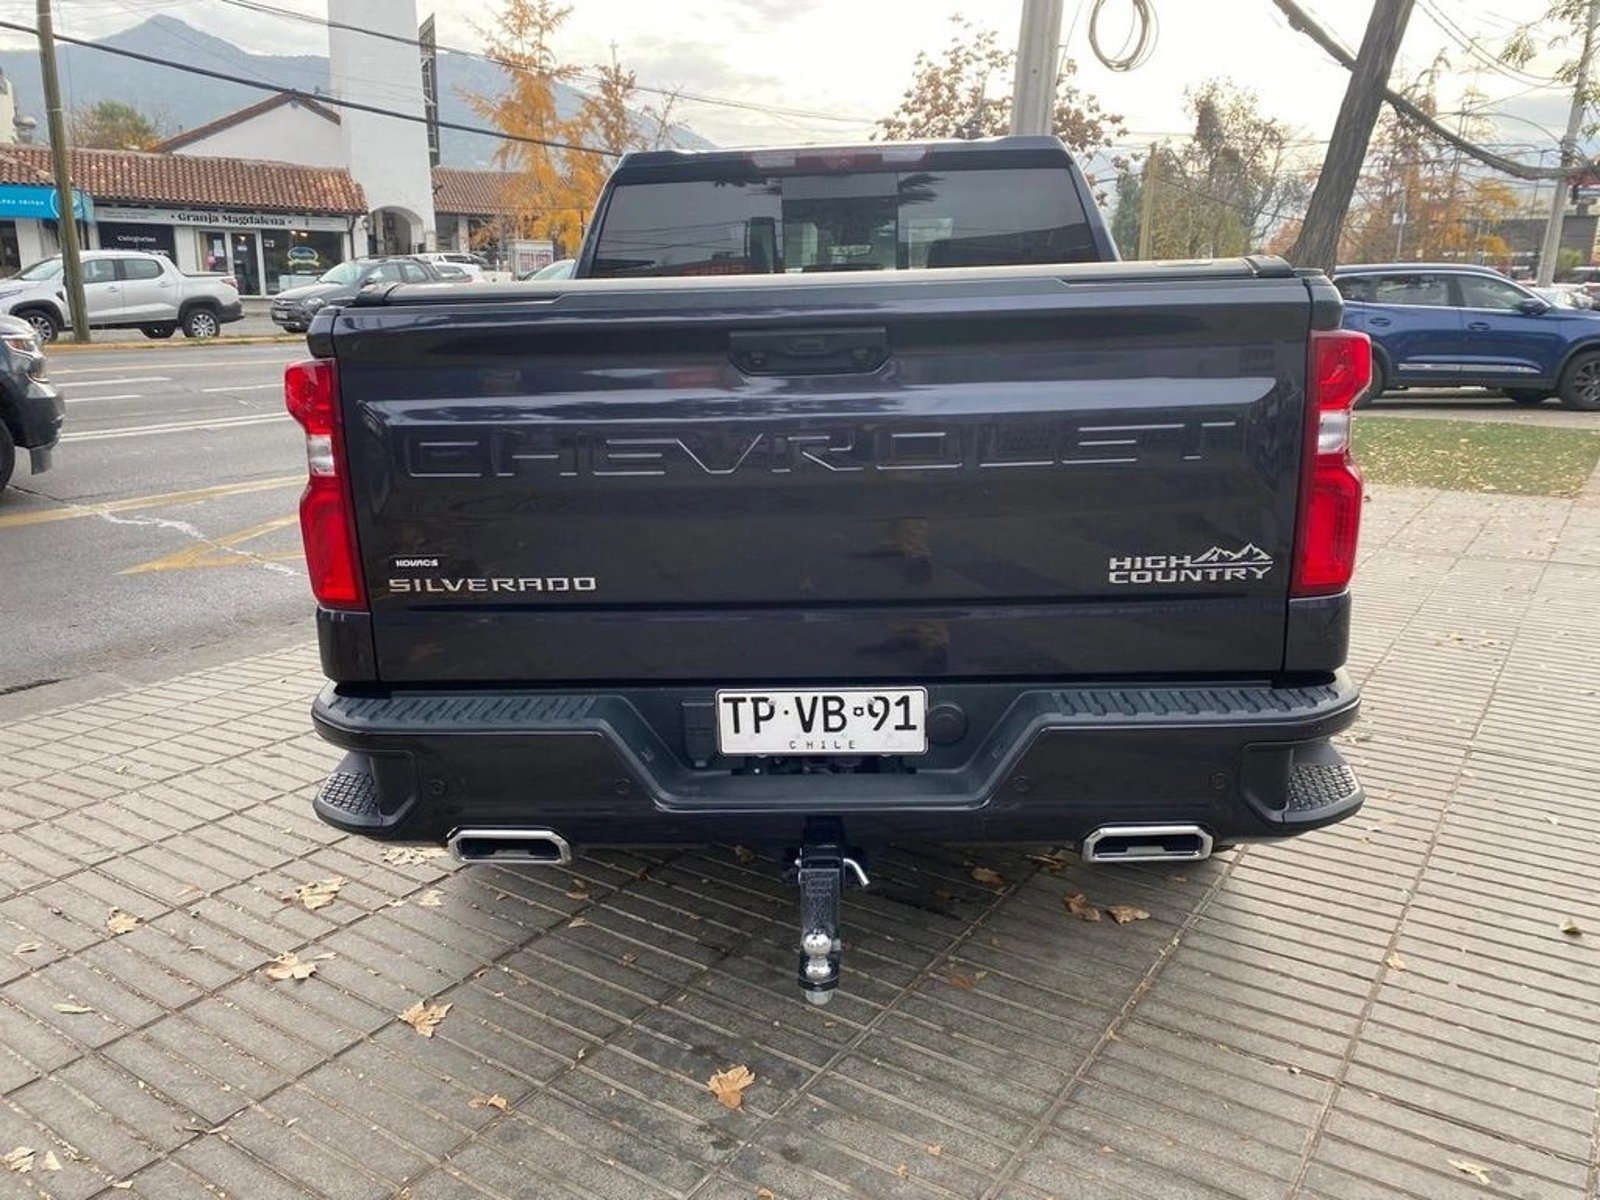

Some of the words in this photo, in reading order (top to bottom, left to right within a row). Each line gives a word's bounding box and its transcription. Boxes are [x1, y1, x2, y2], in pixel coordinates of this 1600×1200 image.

[178, 212, 220, 224] Granja
[222, 214, 286, 226] Magdalena
[408, 420, 1238, 478] CHEVROLET
[395, 558, 439, 568] KOVACS
[1108, 555, 1192, 570] HIGH
[1108, 566, 1272, 584] COUNTRY
[388, 576, 598, 592] SILVERADO
[788, 740, 857, 750] CHILE
